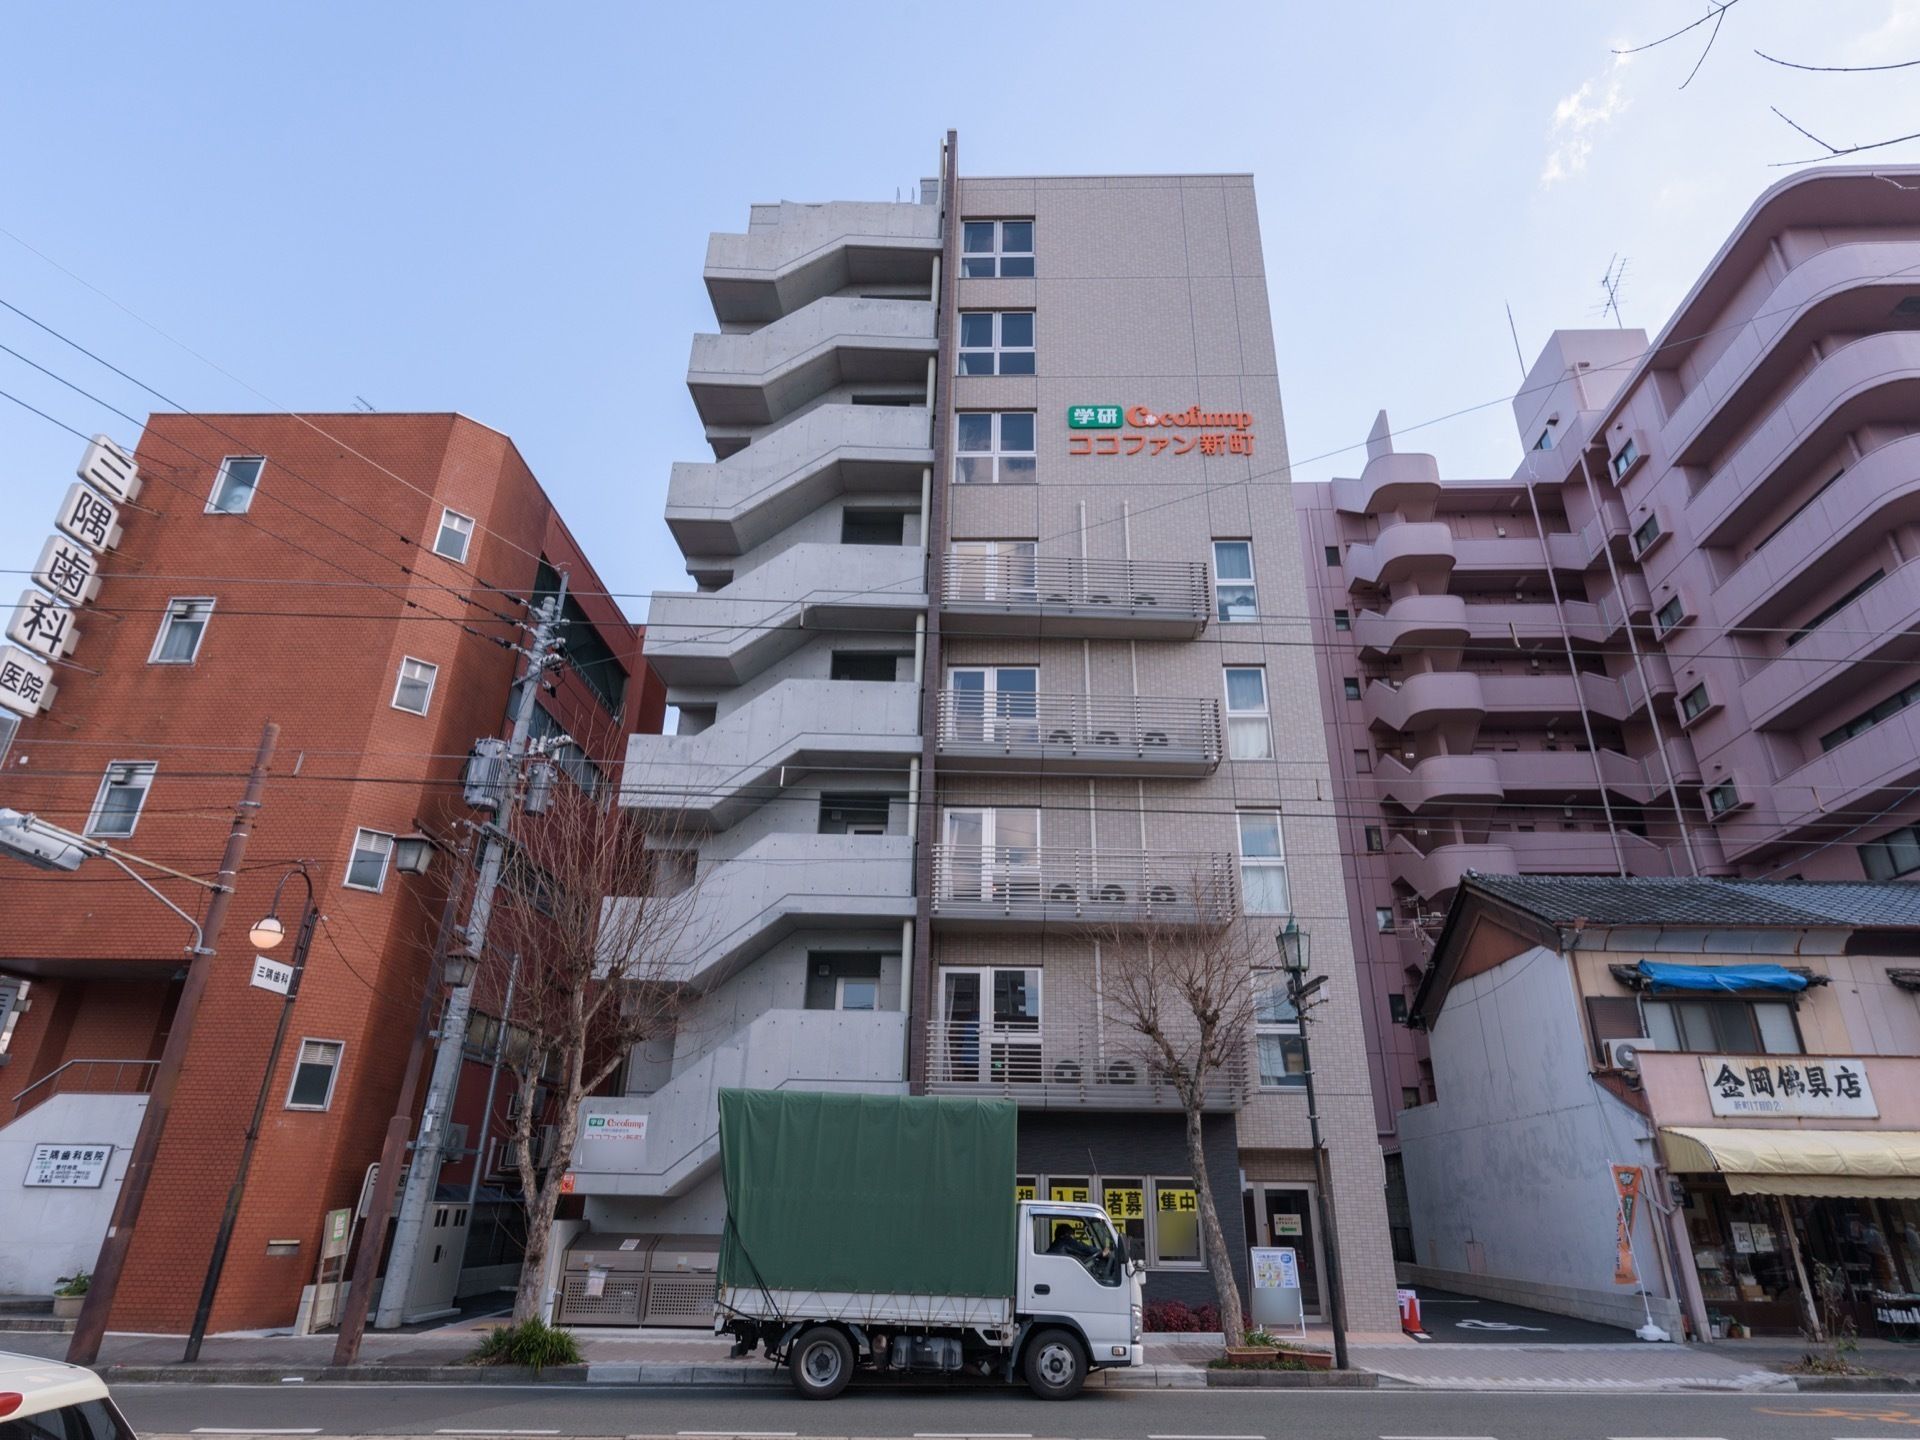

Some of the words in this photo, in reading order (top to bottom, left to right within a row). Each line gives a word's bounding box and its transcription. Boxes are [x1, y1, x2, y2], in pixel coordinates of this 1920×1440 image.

[1073, 408, 1118, 424] 学研
[1127, 405, 1253, 431] Cocofump
[1069, 433, 1255, 455] ココファン新町
[37, 1149, 105, 1161] 三隅歯科医院
